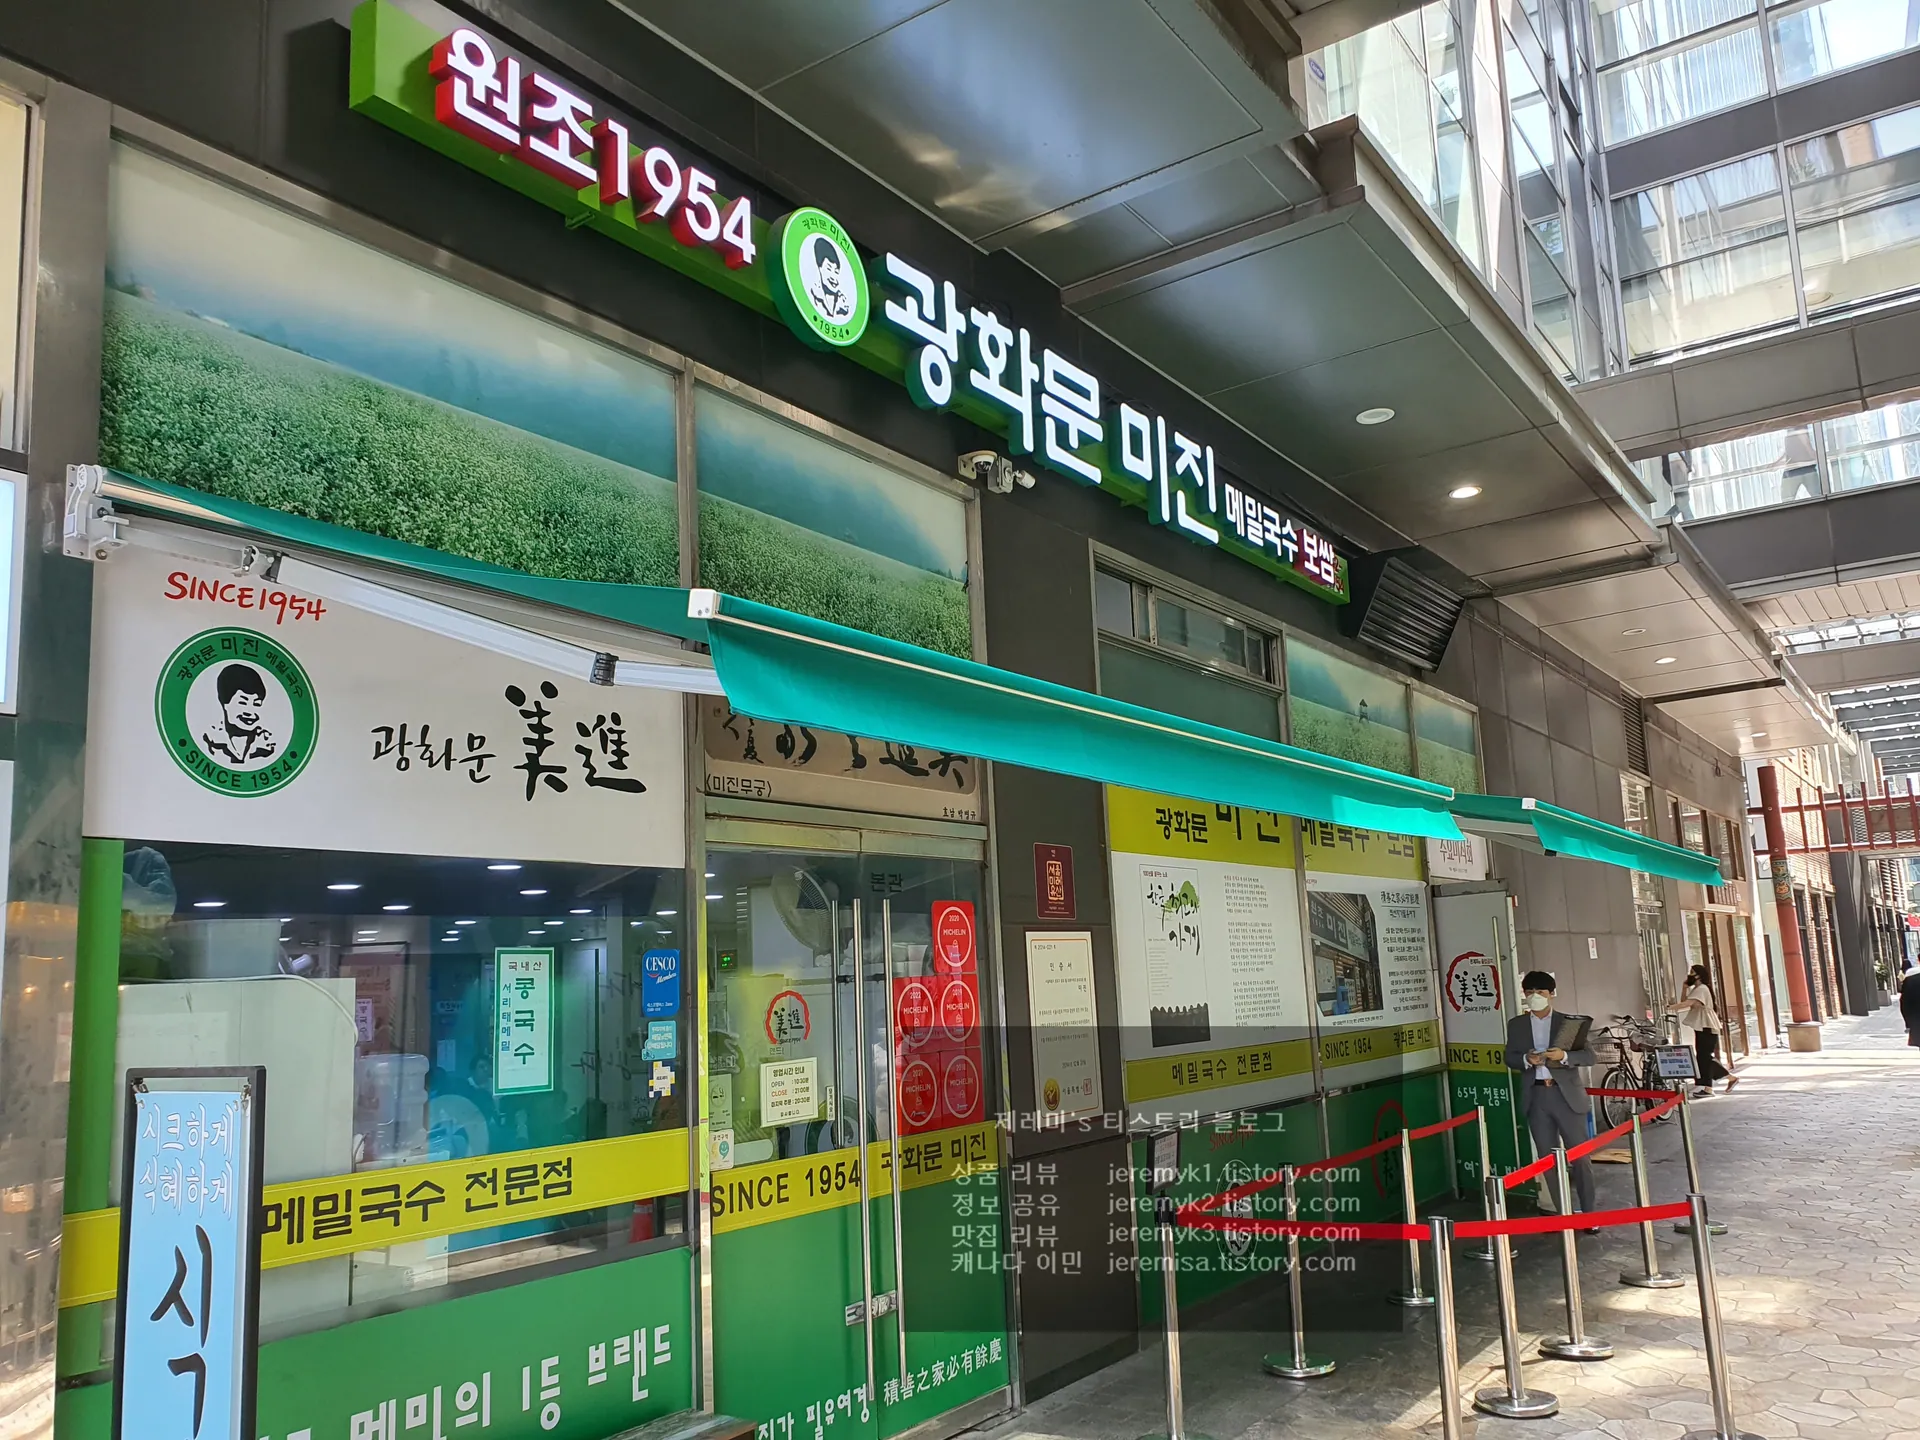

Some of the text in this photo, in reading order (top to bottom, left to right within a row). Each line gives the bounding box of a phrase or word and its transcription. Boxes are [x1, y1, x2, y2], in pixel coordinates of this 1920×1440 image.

[802, 217, 850, 253] 광화문 미진
[818, 319, 844, 340] 1954
[885, 252, 1219, 544] 광화문 미진
[1224, 483, 1334, 584] 메밀국수 보쌈
[177, 636, 304, 698] 광화문 미진 메밀국수
[371, 722, 498, 784] 광화문
[504, 680, 648, 801] 美進
[185, 750, 293, 788] SINCE 1954
[1156, 807, 1208, 844] 광화문
[871, 873, 903, 892] 본관
[1327, 913, 1347, 944] 미진
[508, 961, 542, 972] 국내산
[645, 956, 676, 971] CESCO
[1455, 970, 1494, 1005] 美進
[514, 977, 536, 1064] 콩국수
[774, 1007, 804, 1038] 美進
[903, 1006, 928, 1014] MICHELIN
[1325, 1037, 1372, 1060] SINCE 1954
[1393, 1026, 1430, 1048] 광화문 미진
[773, 1066, 805, 1077] 영업시간 안내
[1172, 1051, 1273, 1086] 메밀국수 전문점
[1449, 1049, 1479, 1063] INCE
[905, 1084, 931, 1093] MICHELIN
[949, 1078, 973, 1086] MICHELIN
[1457, 1086, 1479, 1106] 65년
[142, 1103, 234, 1157] 시크하게
[951, 1132, 987, 1164] 미진
[139, 1155, 233, 1220] 식혜하게
[262, 1157, 573, 1245] 메밀국수 전문점
[712, 1159, 861, 1217] SINCE 1954
[588, 1324, 671, 1402] 브랜드
[806, 1383, 870, 1440] 필유여경
